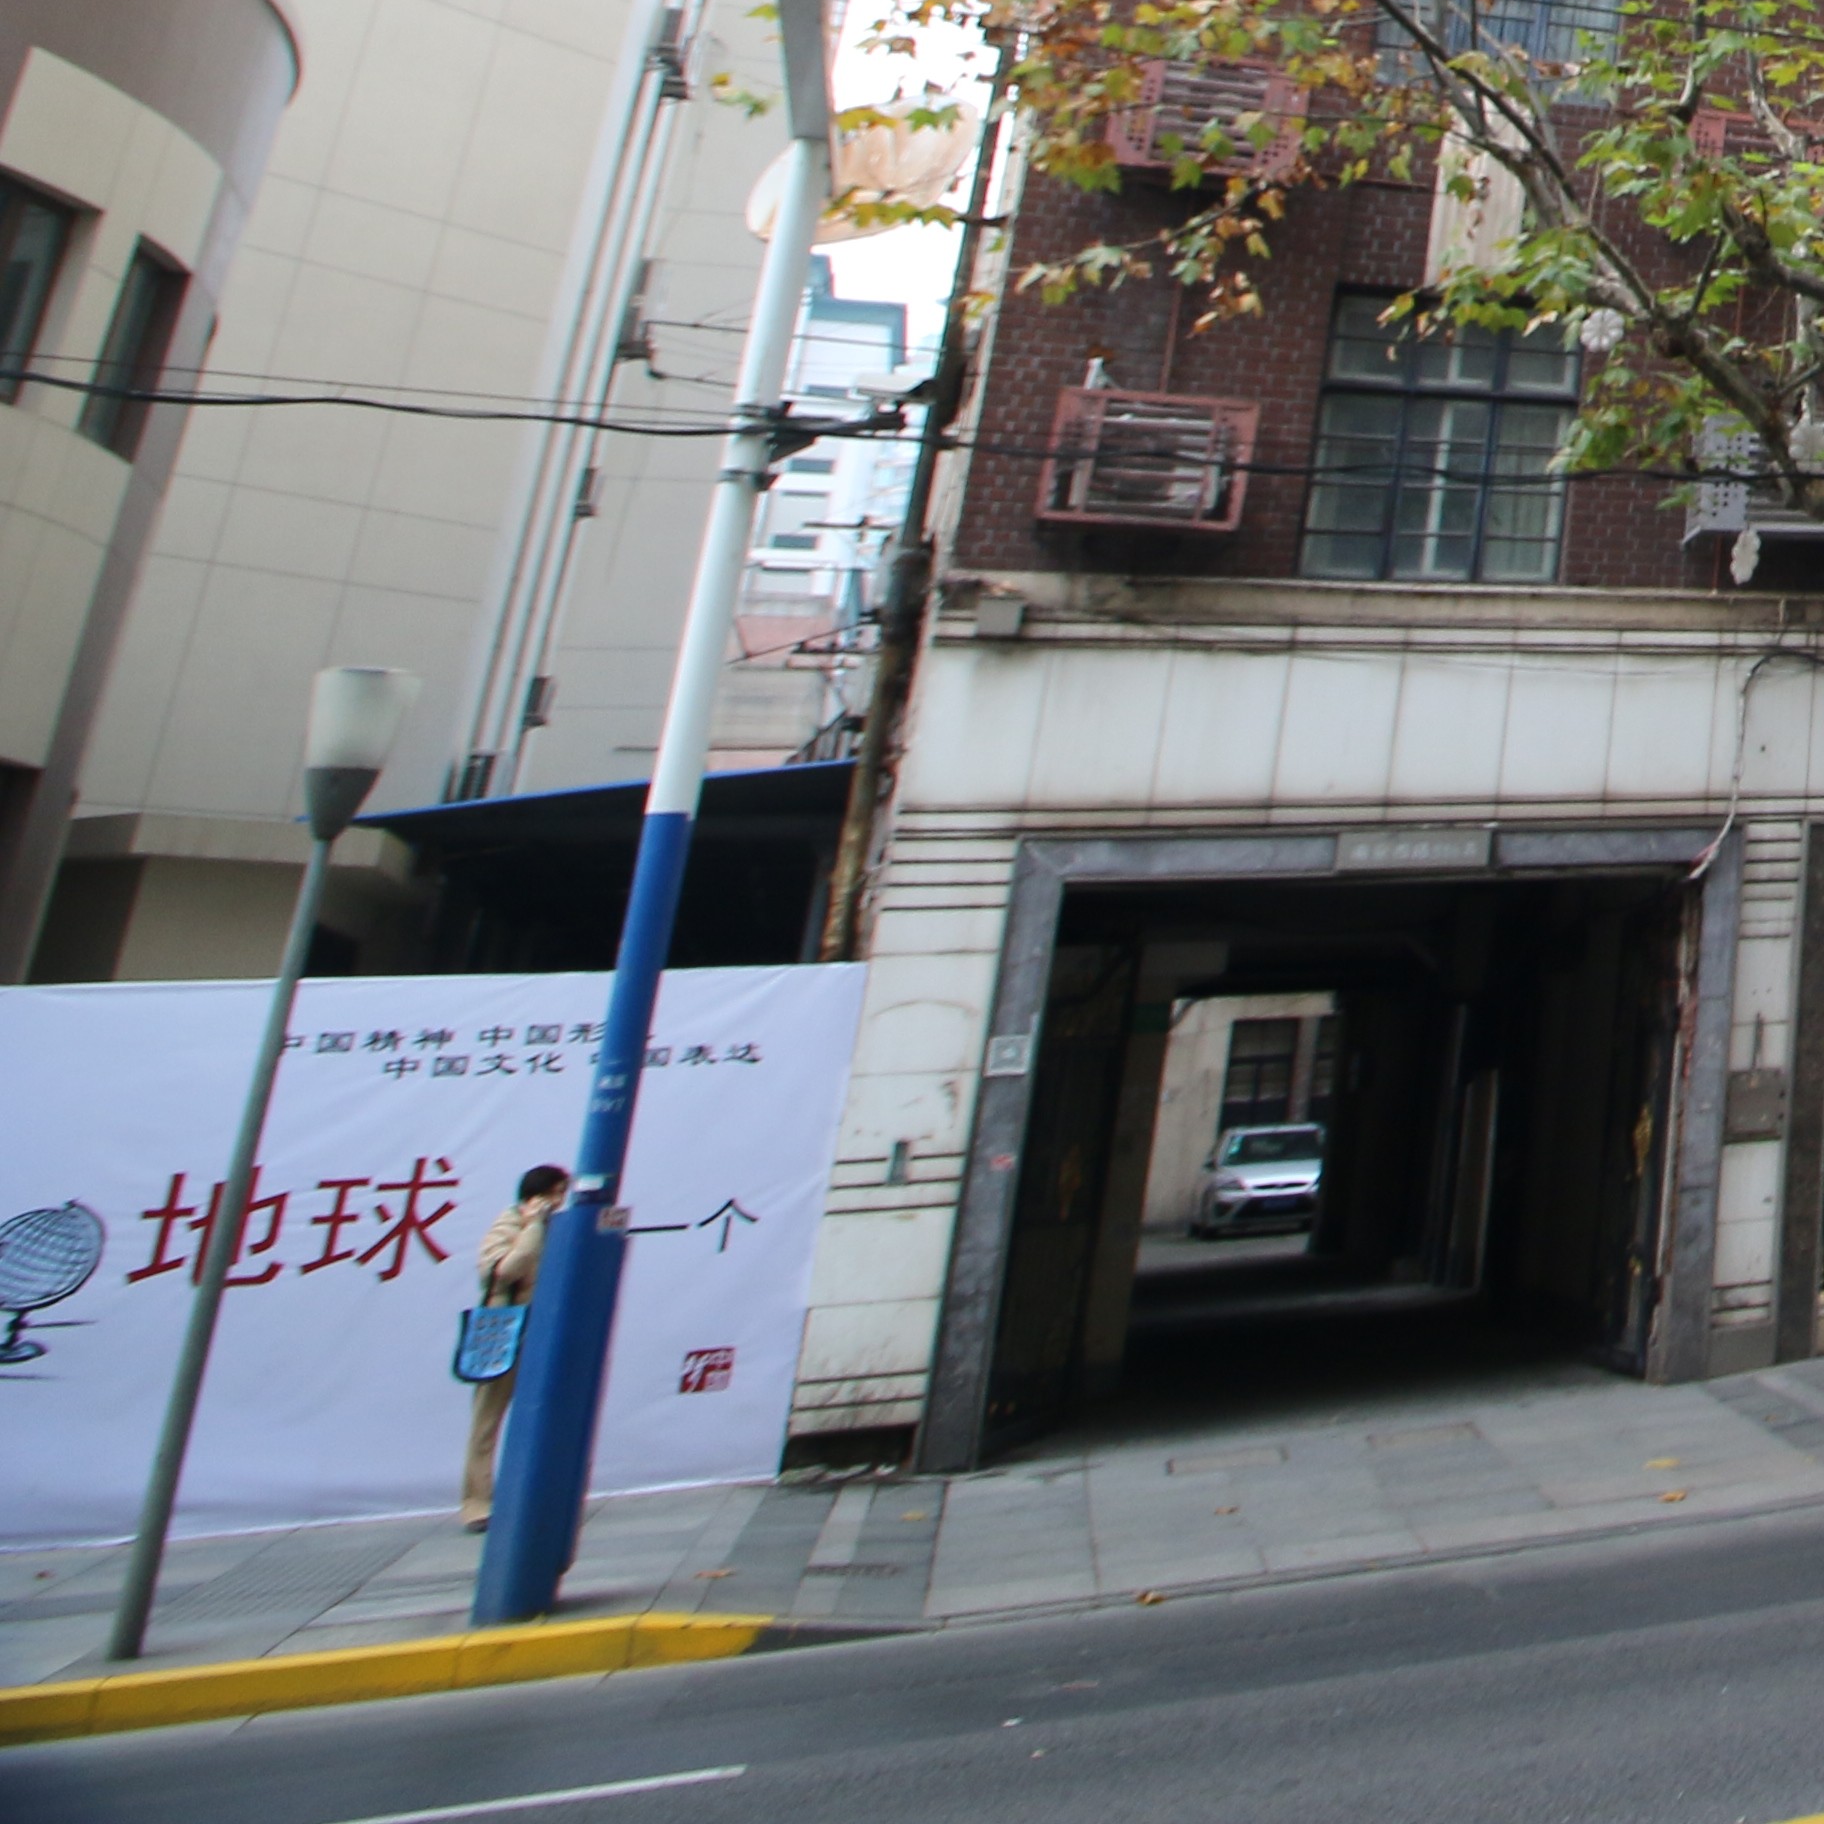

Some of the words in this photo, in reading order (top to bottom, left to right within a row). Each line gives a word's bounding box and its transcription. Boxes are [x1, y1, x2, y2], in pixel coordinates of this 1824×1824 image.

[384, 1053, 564, 1078] 中国文化
[125, 1155, 460, 1288] 地球
